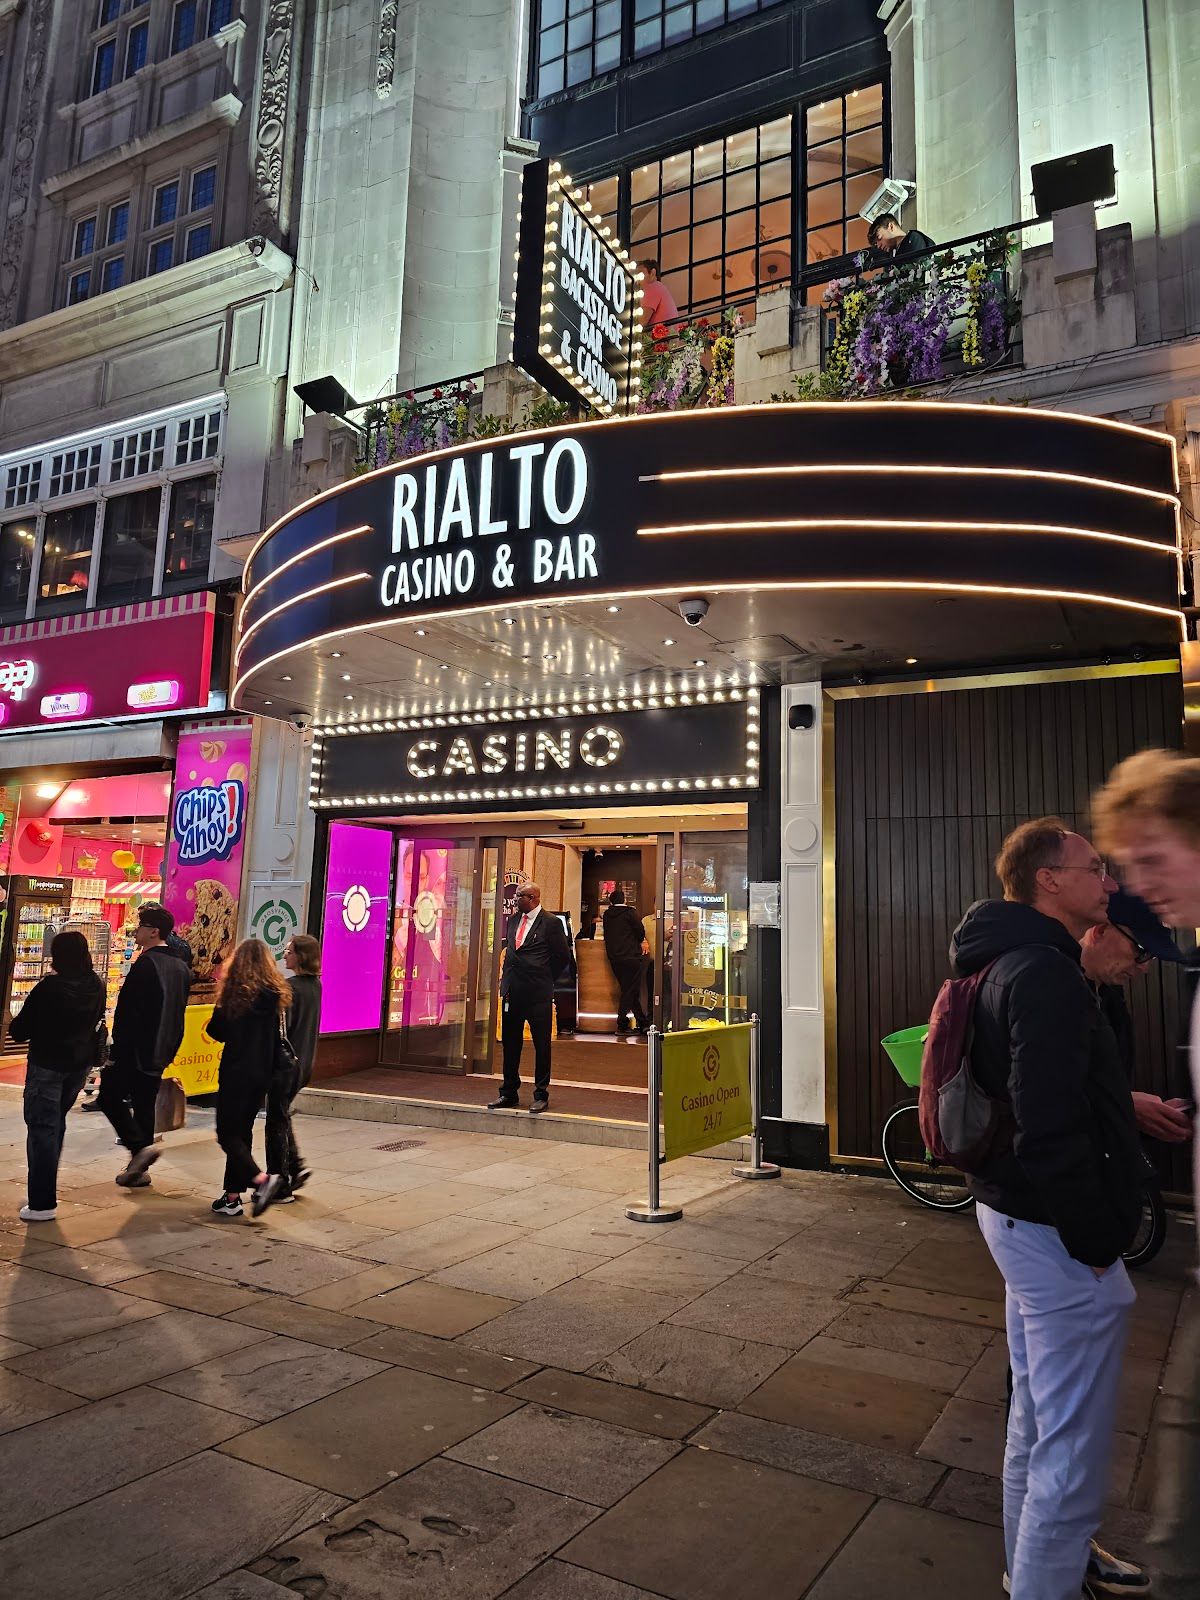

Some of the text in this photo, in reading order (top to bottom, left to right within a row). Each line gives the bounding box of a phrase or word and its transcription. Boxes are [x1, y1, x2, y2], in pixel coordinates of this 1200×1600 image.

[561, 200, 626, 314] RIALTO
[560, 262, 623, 351] BACKSTAGE
[579, 313, 604, 360] BAR
[560, 330, 617, 408] & CASINO
[390, 437, 589, 554] RIALTO
[380, 533, 599, 608] CASINO & BAR
[406, 726, 624, 779] CASINO
[177, 790, 227, 832] Chips
[681, 1086, 740, 1112] Casino Open
[703, 1111, 723, 1131] 24/7
